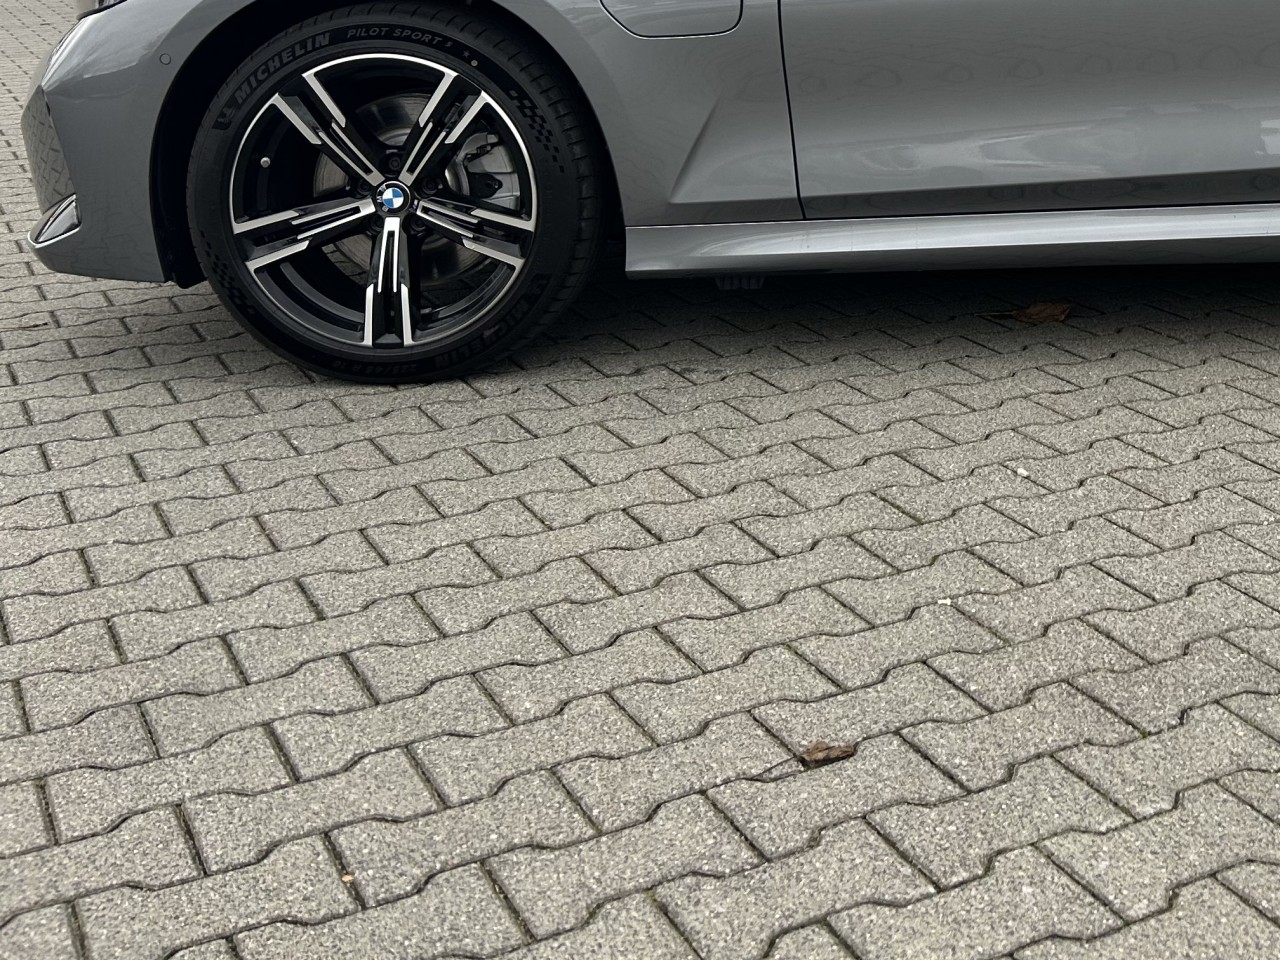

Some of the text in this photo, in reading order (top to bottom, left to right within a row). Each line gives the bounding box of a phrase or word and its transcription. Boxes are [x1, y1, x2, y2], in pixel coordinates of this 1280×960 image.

[233, 31, 331, 104] MICHELIN
[346, 27, 389, 39] PILOT
[392, 28, 443, 45] SPORT
